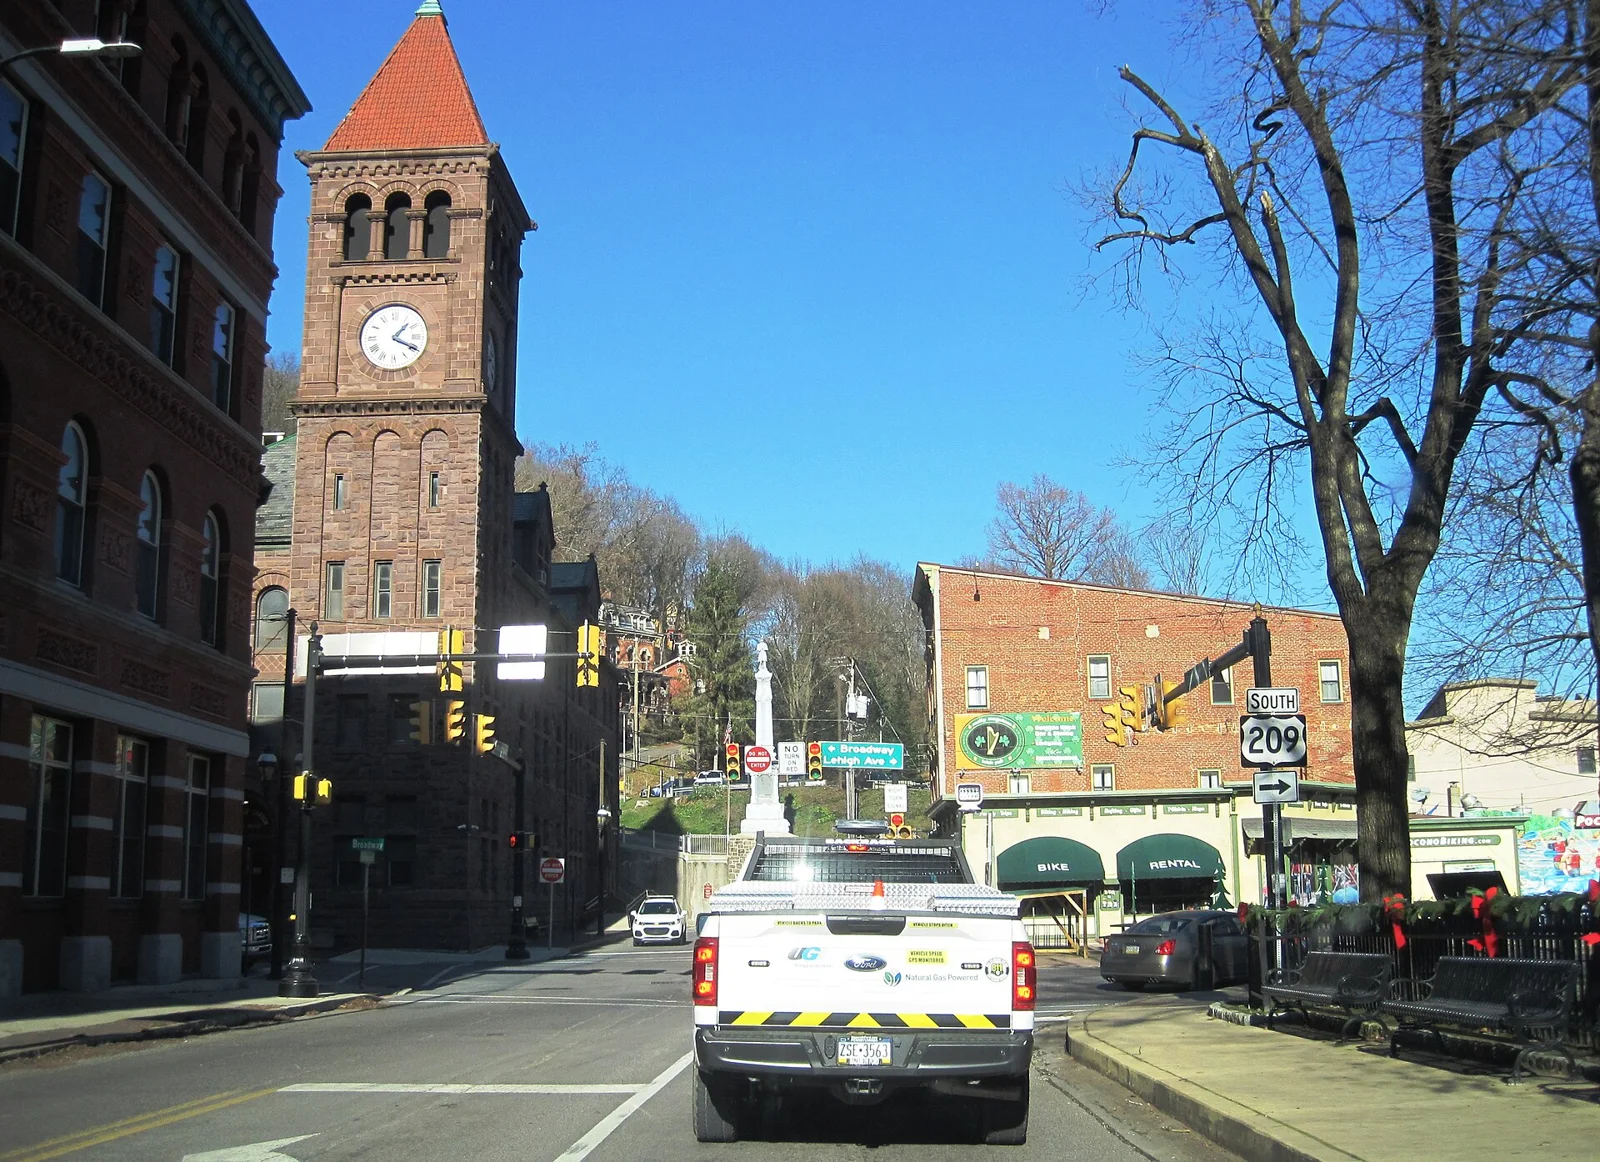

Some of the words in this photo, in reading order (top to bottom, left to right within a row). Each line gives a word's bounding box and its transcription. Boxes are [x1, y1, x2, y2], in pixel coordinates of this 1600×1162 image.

[1251, 693, 1295, 709] SOUTH
[1249, 726, 1299, 754] 209
[840, 744, 894, 756] Broadway
[823, 755, 860, 767] Lehigh
[864, 756, 885, 765] Ave
[352, 838, 384, 851] Broadway
[1037, 863, 1069, 872] BIKE
[1150, 859, 1201, 870] RENTAL
[905, 973, 932, 981] Natural
[933, 973, 947, 981] Gas
[947, 973, 978, 981] Powered
